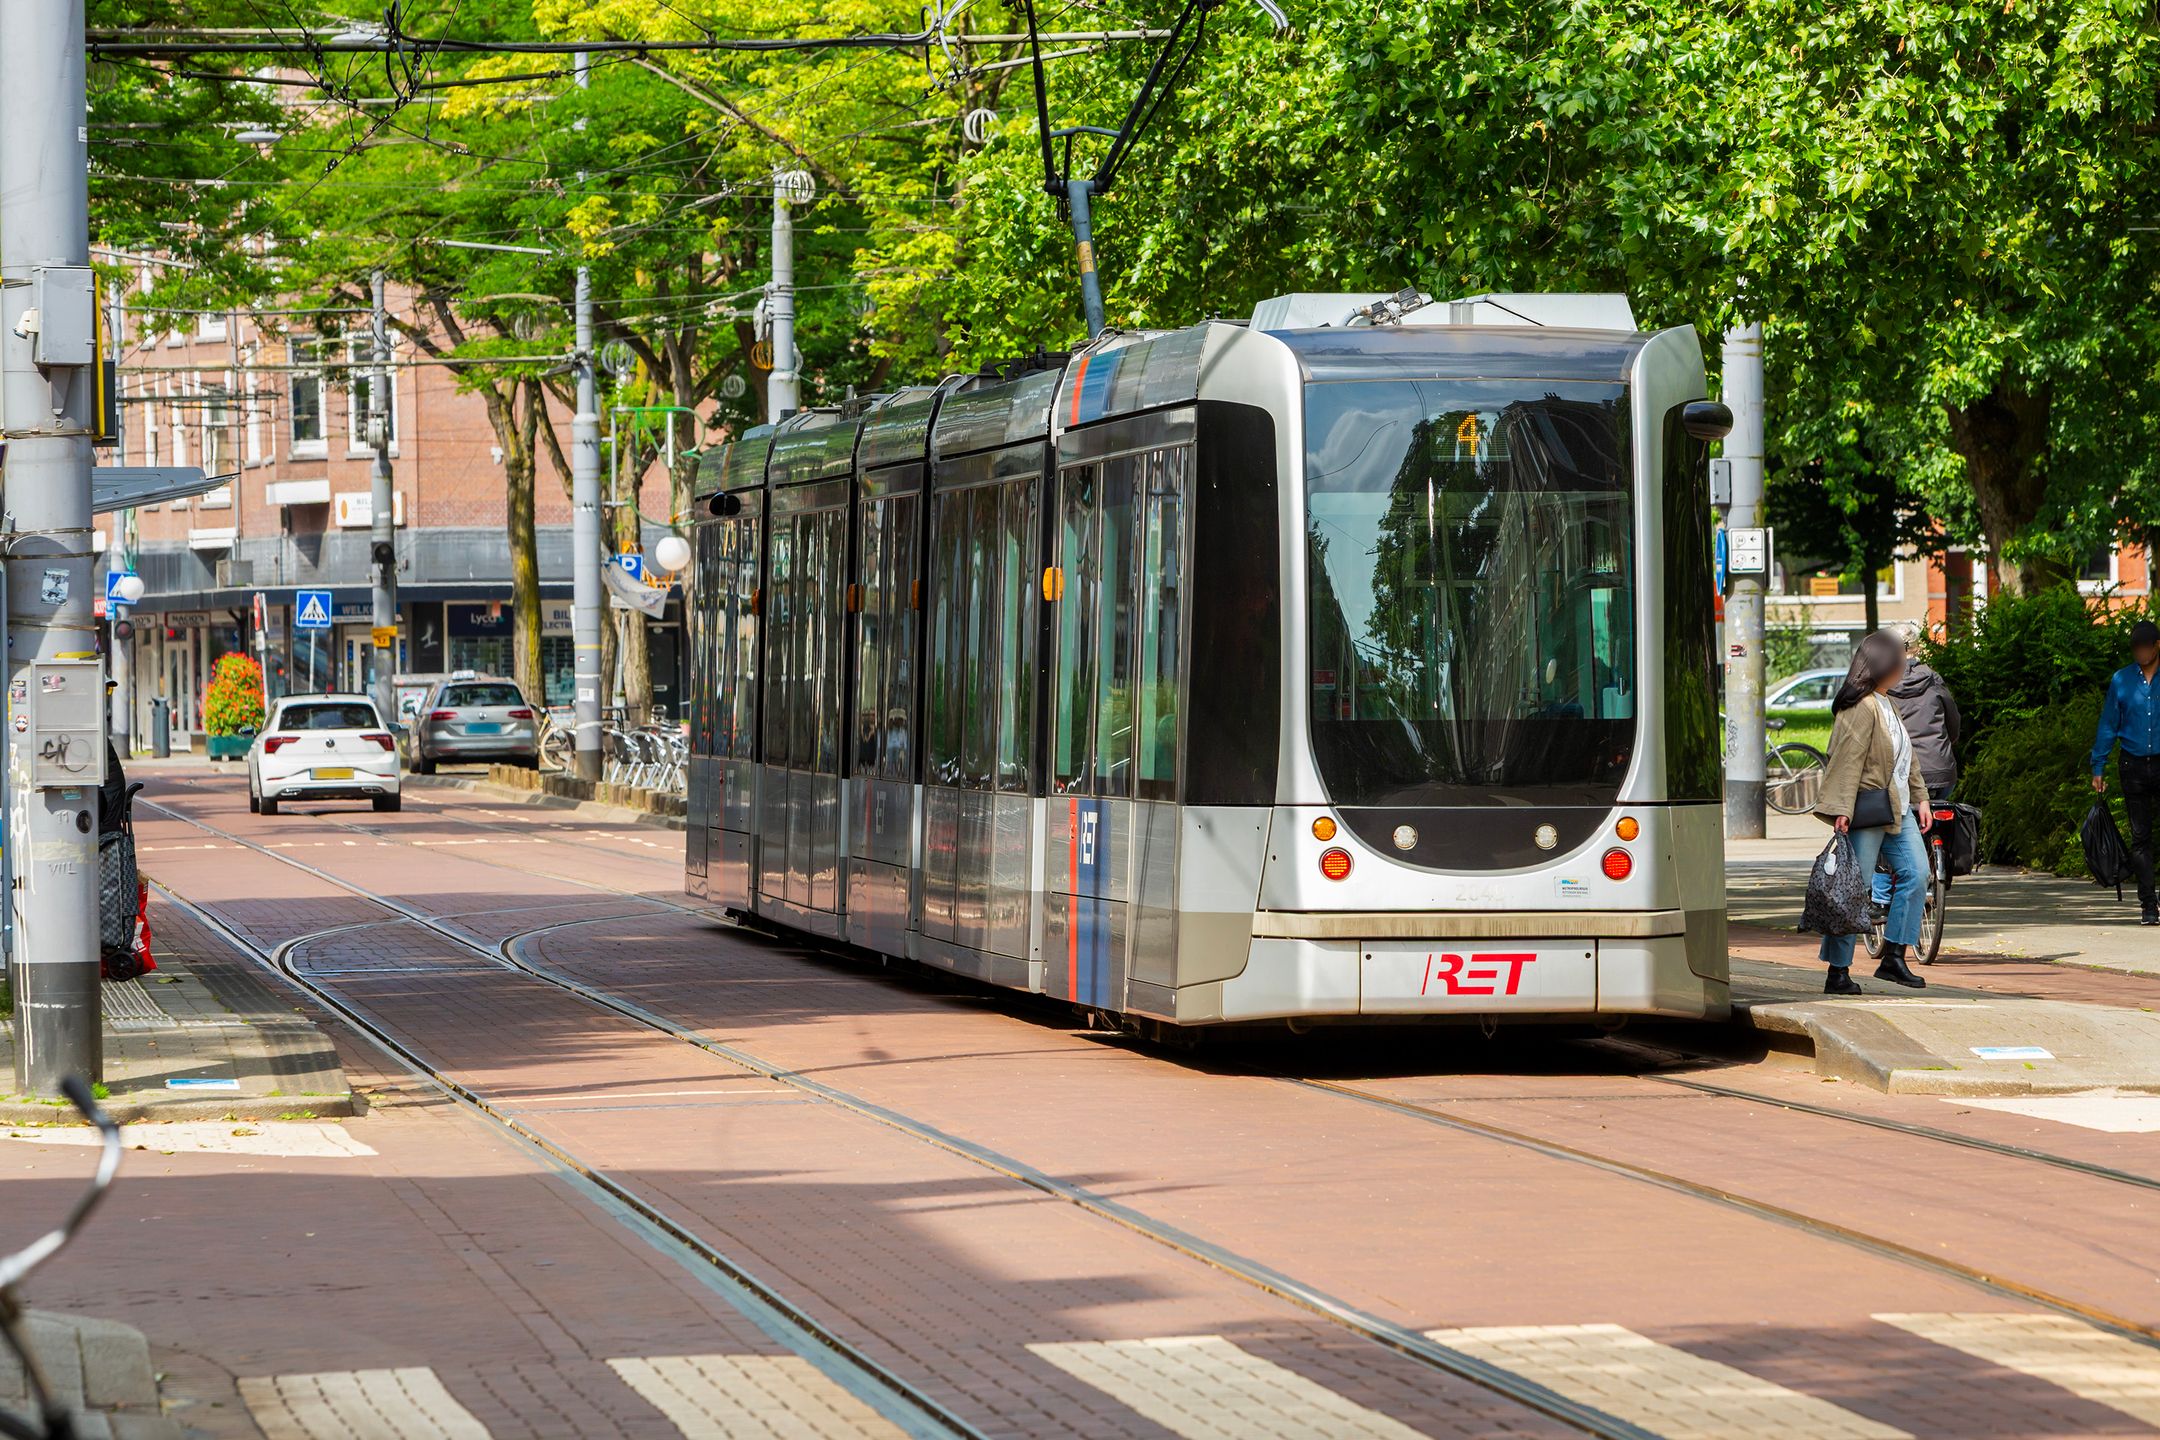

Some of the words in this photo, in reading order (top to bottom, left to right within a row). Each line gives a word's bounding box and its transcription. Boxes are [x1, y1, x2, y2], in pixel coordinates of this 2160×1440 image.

[1458, 414, 1480, 456] 4
[544, 621, 572, 629] LECTR
[1437, 953, 1537, 995] RET
